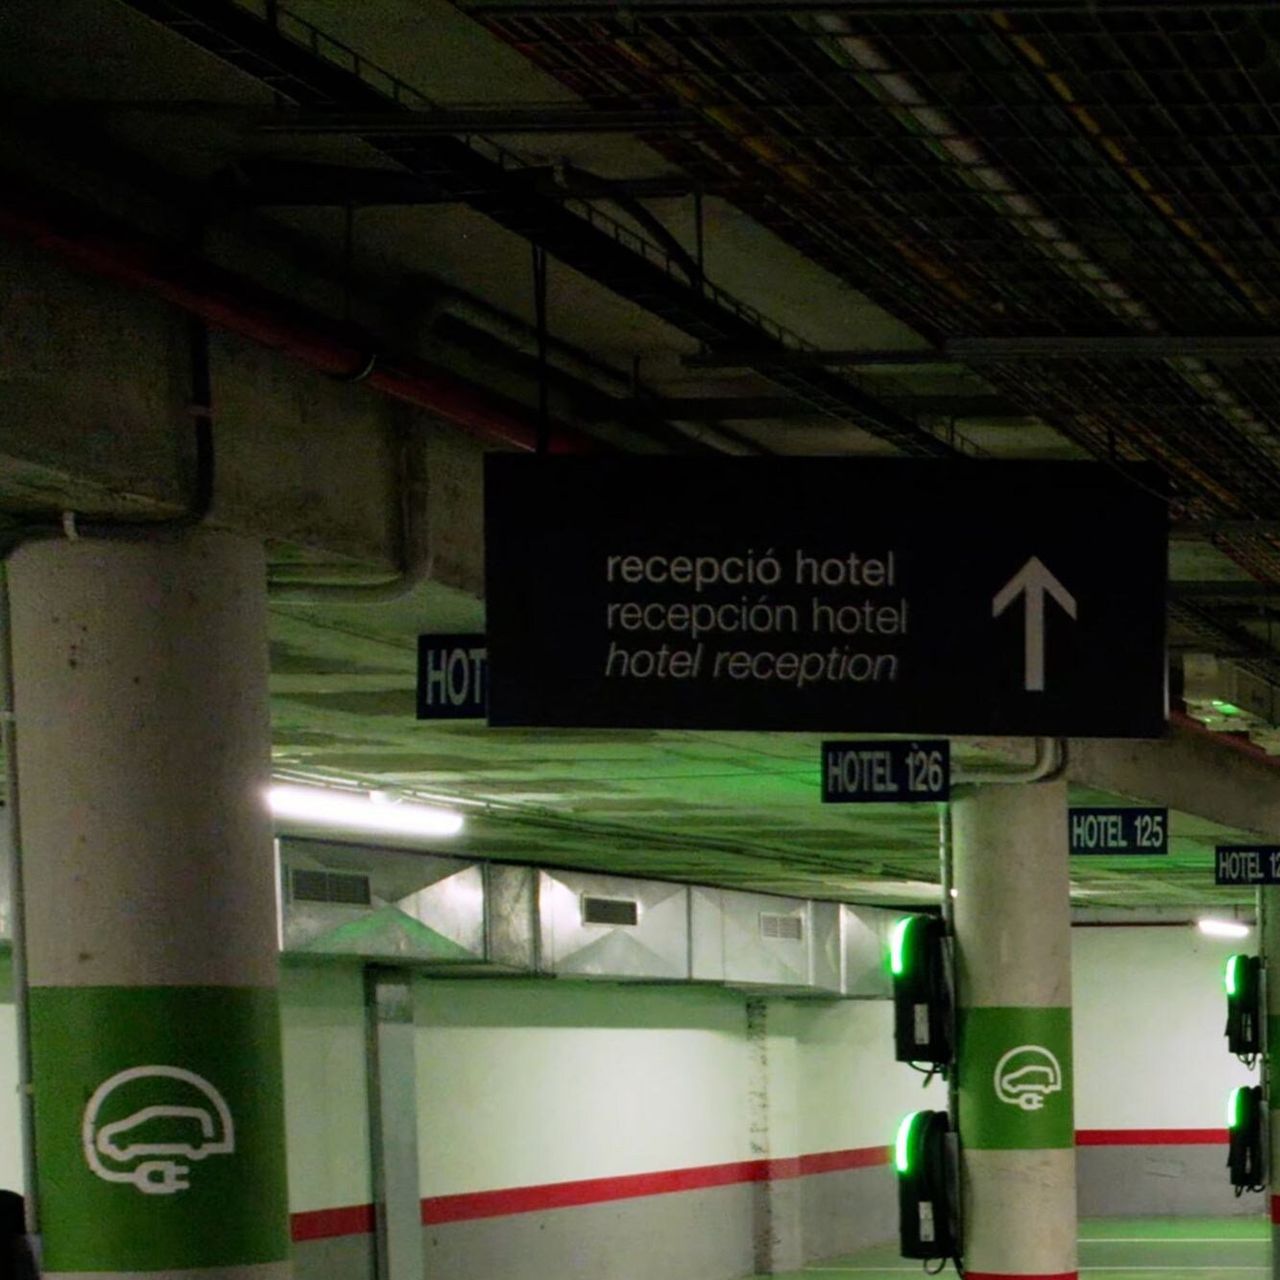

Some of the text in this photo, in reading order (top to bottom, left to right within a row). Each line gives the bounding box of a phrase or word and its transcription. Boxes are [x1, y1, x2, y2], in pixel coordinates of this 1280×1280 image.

[606, 548, 896, 592] recepció hotel
[606, 596, 909, 639] recepción hotel
[425, 647, 486, 706] HOT
[604, 641, 899, 687] hotel reception
[828, 749, 944, 793] HOTEL 126
[1072, 814, 1164, 848] HOTEL 125
[1219, 851, 1265, 879] HOTEL
